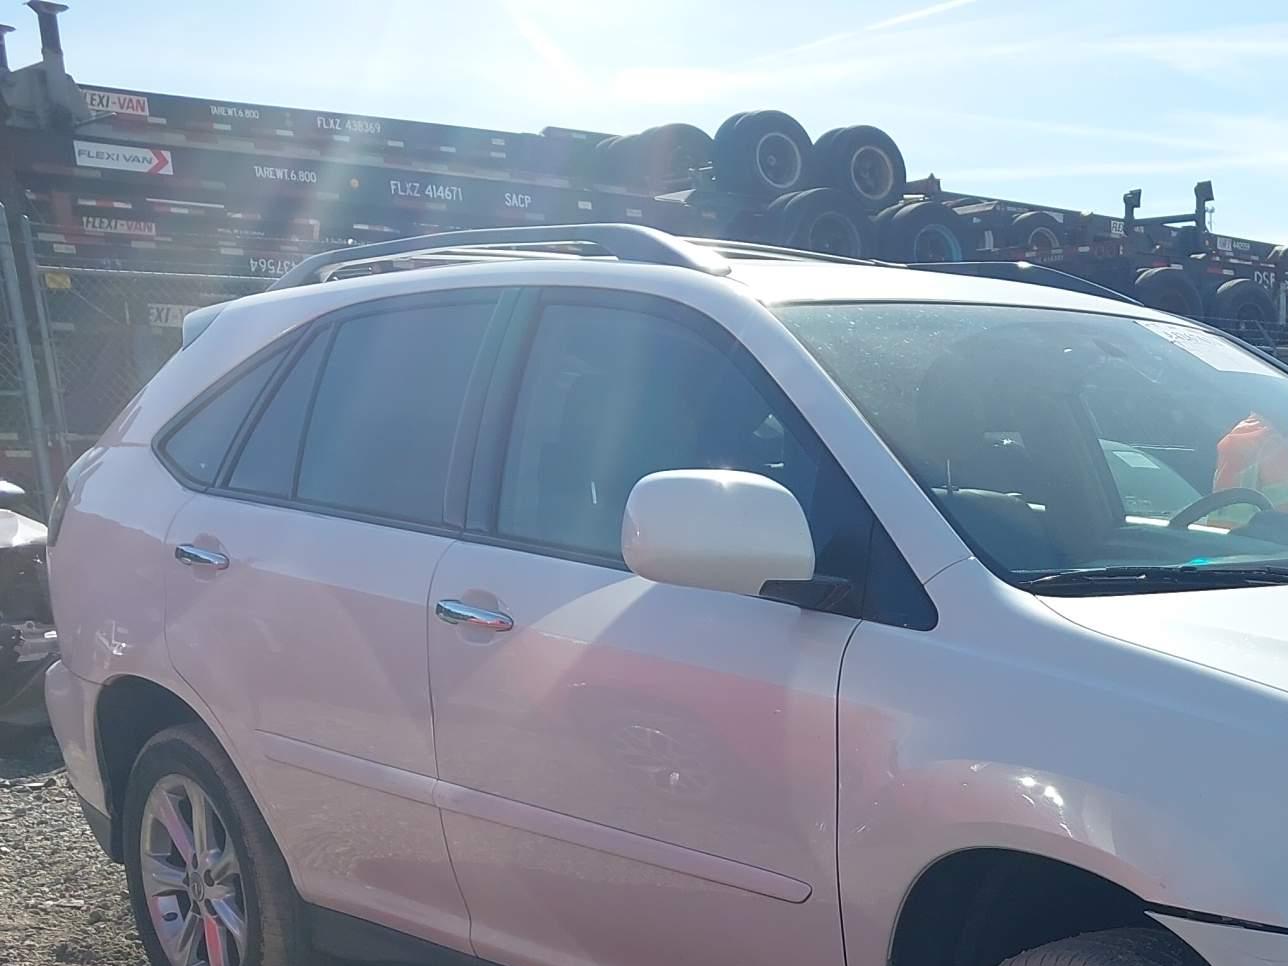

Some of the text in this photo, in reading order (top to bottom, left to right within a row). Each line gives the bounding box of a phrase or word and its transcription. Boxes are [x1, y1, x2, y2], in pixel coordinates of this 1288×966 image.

[316, 116, 342, 130] FLXZ
[78, 148, 153, 165] FLEXI VAN
[390, 180, 463, 201] FLXZ 414671
[504, 192, 531, 208] SACP
